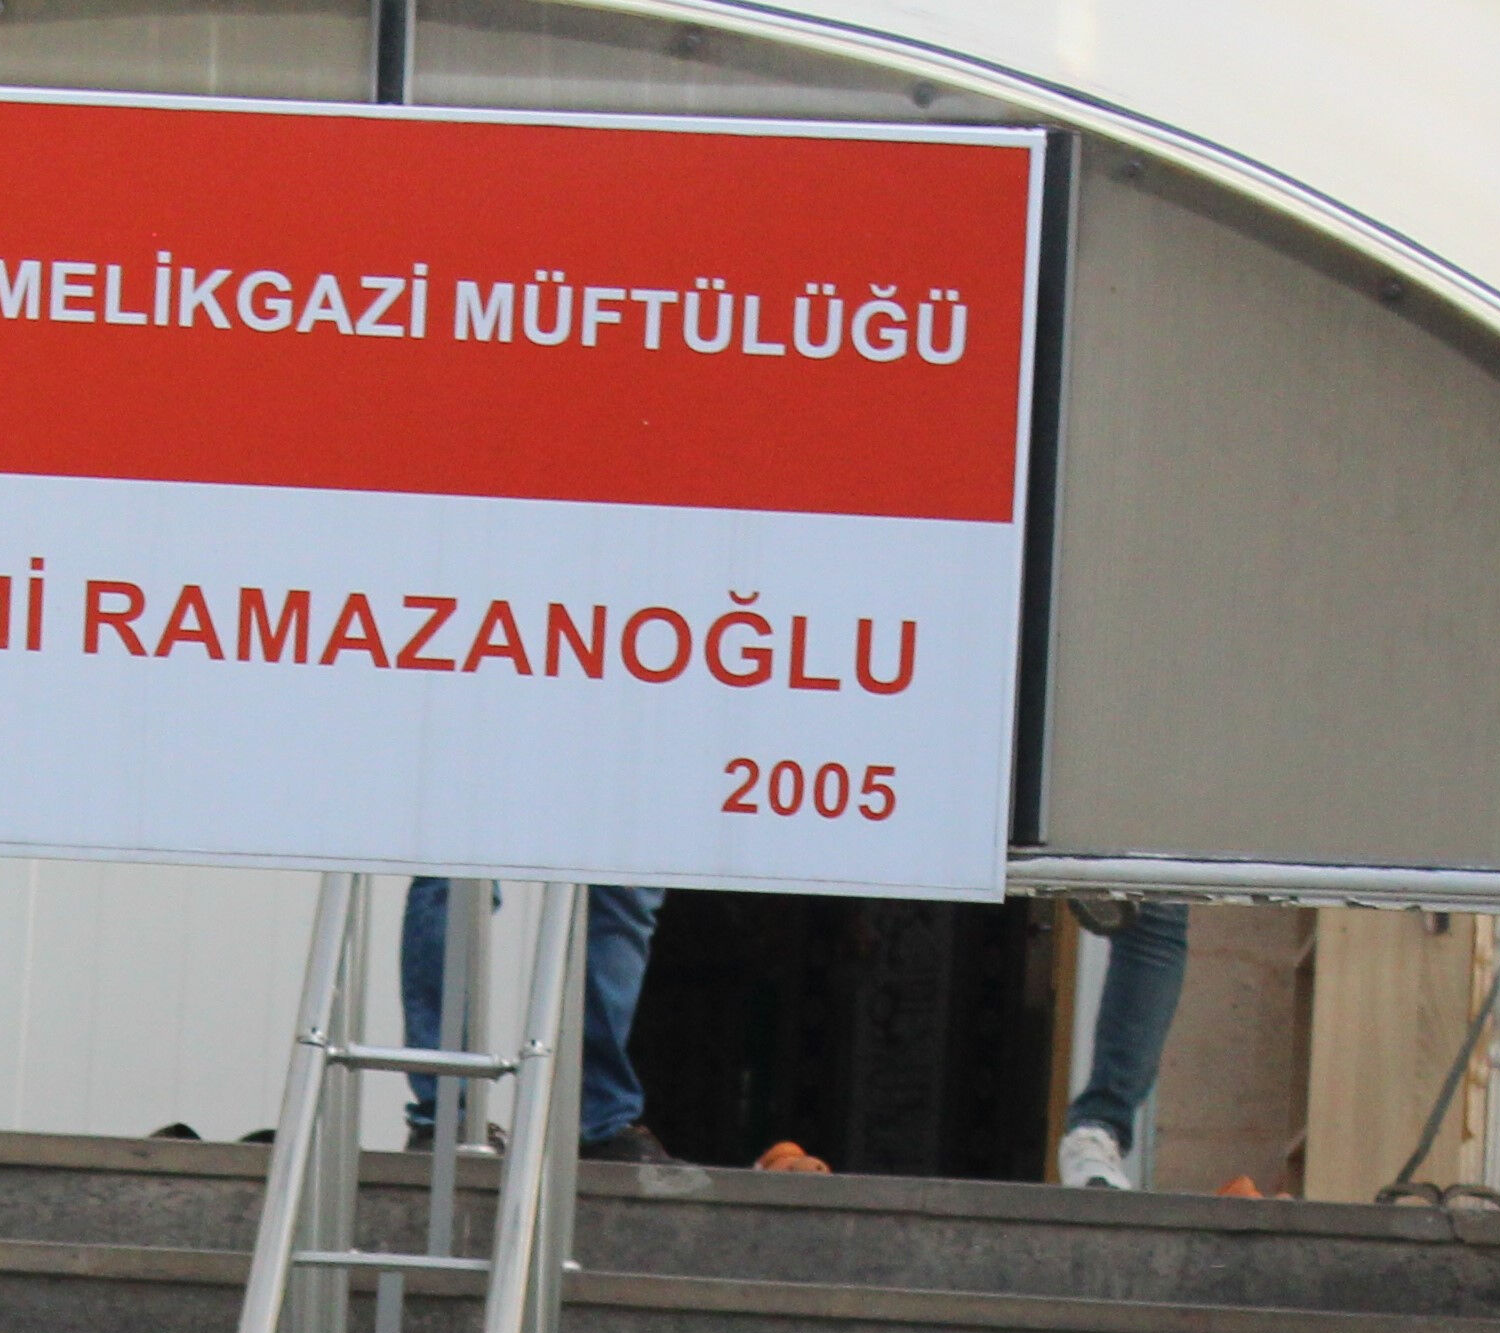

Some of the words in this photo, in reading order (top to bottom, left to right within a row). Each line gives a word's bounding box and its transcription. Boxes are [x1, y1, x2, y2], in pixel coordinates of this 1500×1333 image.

[454, 270, 967, 365] MÜFTÜLÜĞÜ
[83, 579, 916, 696] RAMAZANOĞLU
[722, 757, 896, 821] 2005
